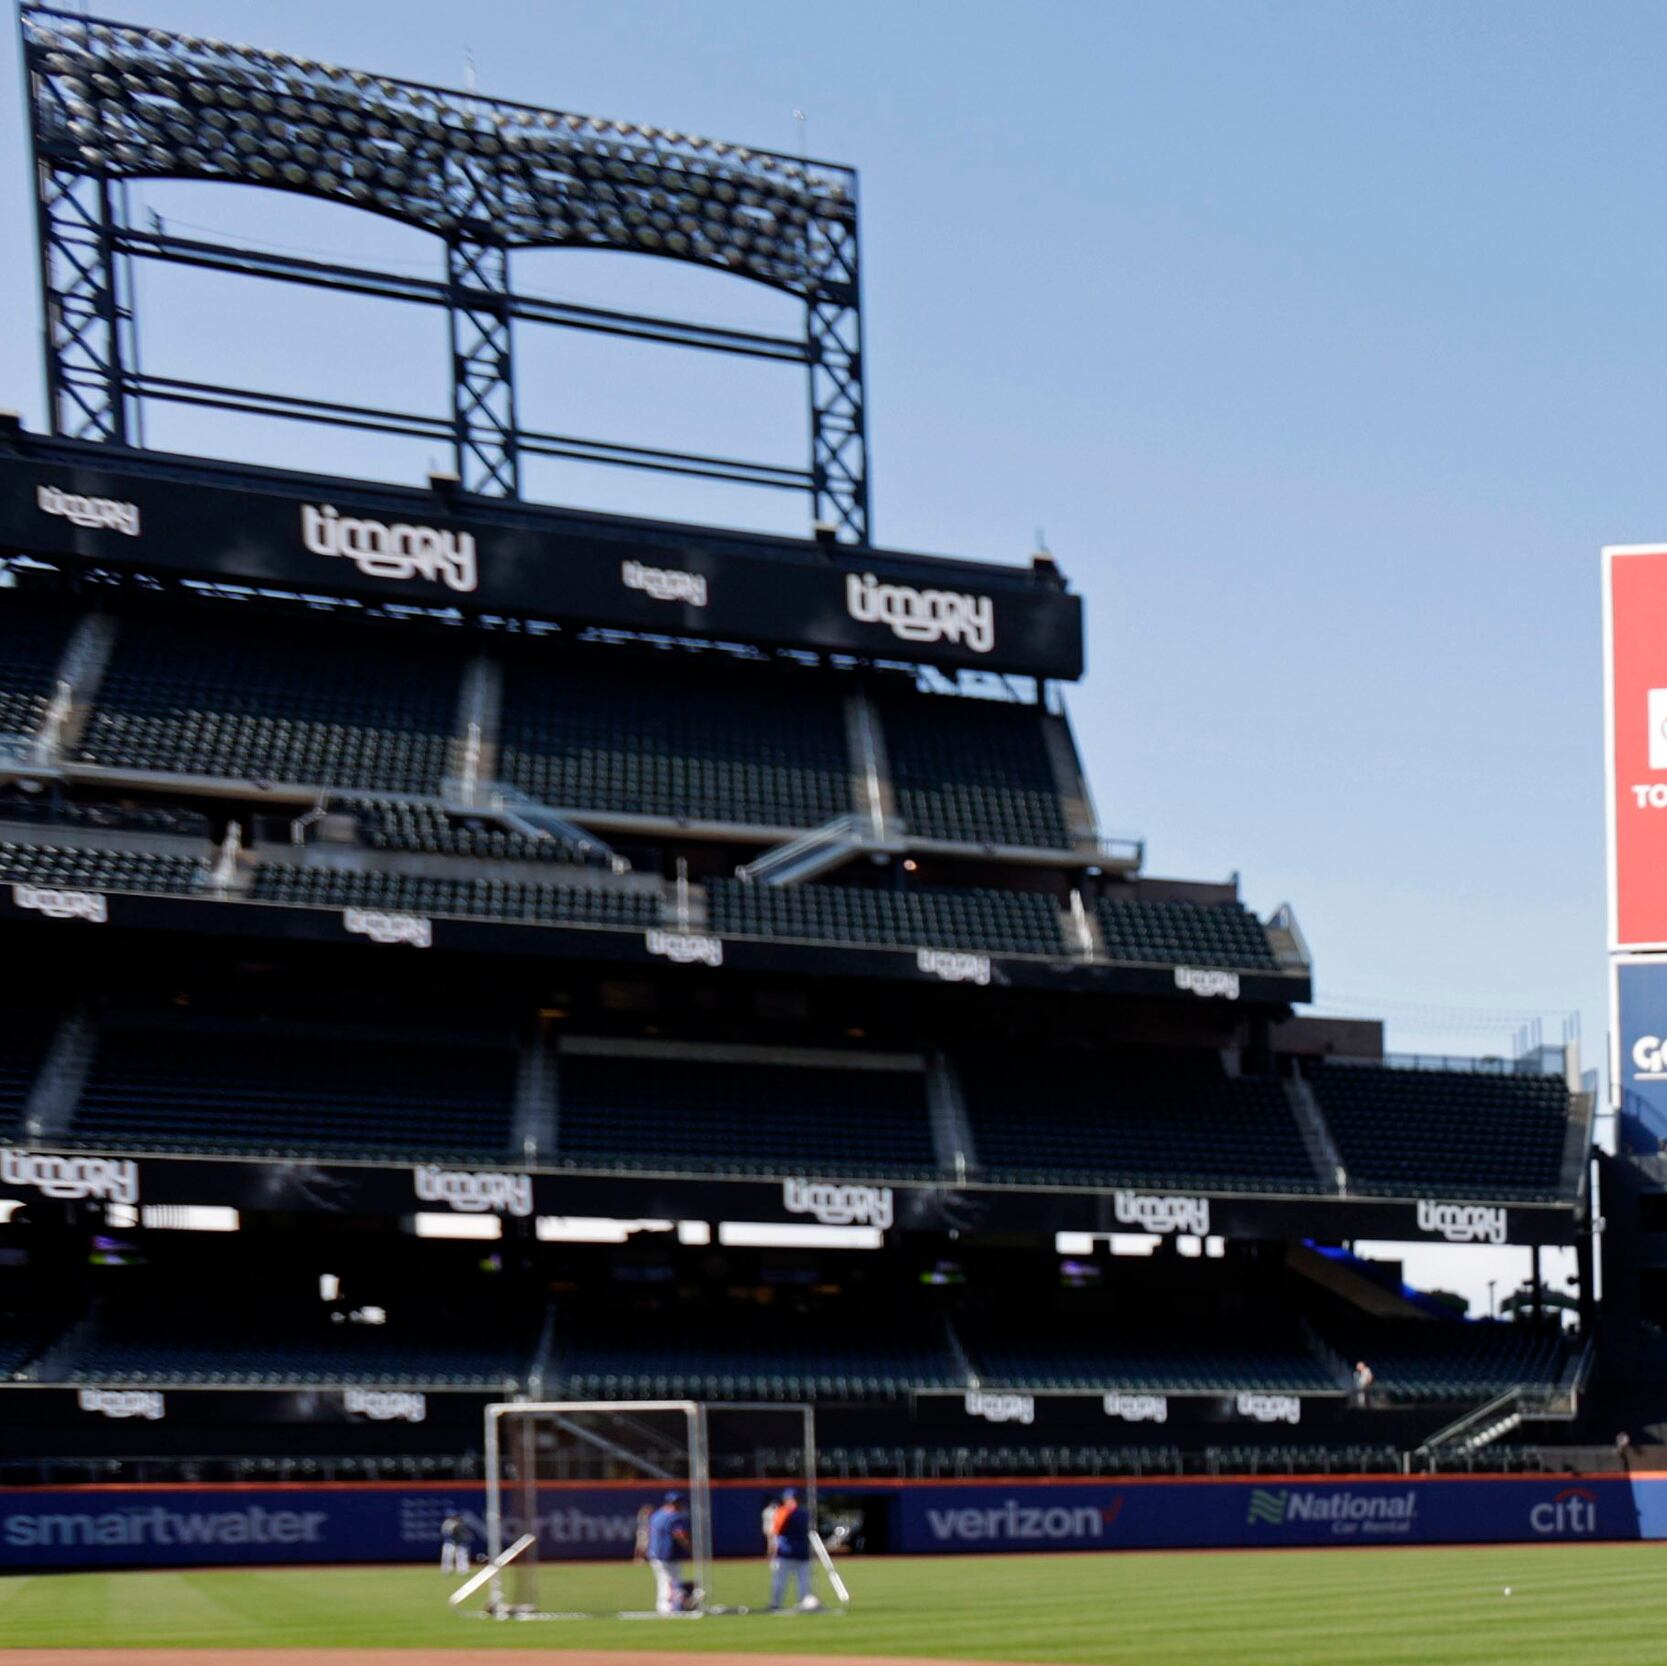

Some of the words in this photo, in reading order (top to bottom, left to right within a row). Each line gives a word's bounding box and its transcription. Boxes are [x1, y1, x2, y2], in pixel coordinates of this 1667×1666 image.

[926, 1498, 1104, 1541] verizon
[1286, 1491, 1417, 1521] National
[1529, 1496, 1596, 1534] citi
[4, 1504, 328, 1547] smartwater
[1331, 1520, 1358, 1534] Car
[1361, 1519, 1410, 1533] Rental
